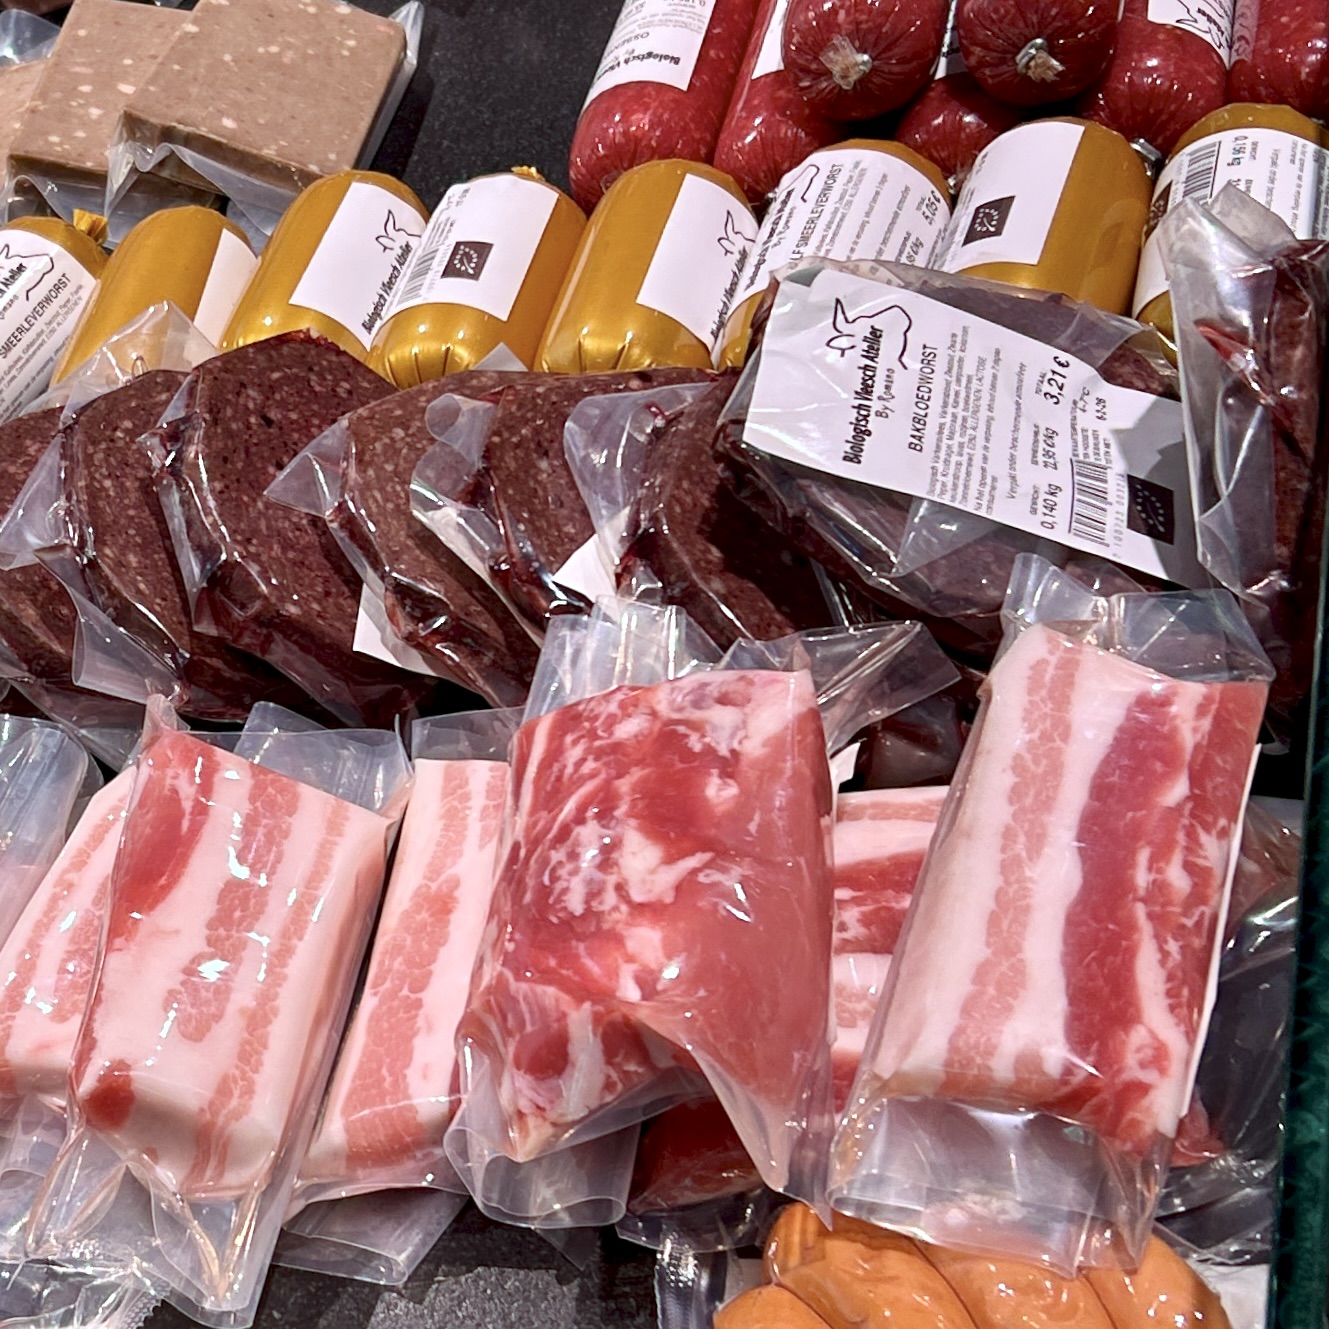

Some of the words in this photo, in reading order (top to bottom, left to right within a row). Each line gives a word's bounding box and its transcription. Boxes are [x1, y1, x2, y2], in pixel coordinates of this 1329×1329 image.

[624, 50, 681, 65] Biologisch
[0, 262, 27, 289] Atelier
[860, 324, 883, 364] Atelier
[1052, 357, 1070, 368] €
[853, 363, 877, 401] Vleesch
[876, 367, 895, 403] Romano
[907, 343, 937, 452] BAKBLOEDWORST
[1042, 368, 1067, 405] 3,21
[874, 403, 892, 419] By
[842, 403, 871, 464] Biologisch
[1043, 482, 1063, 497] kg
[1039, 497, 1057, 530] 0,140
